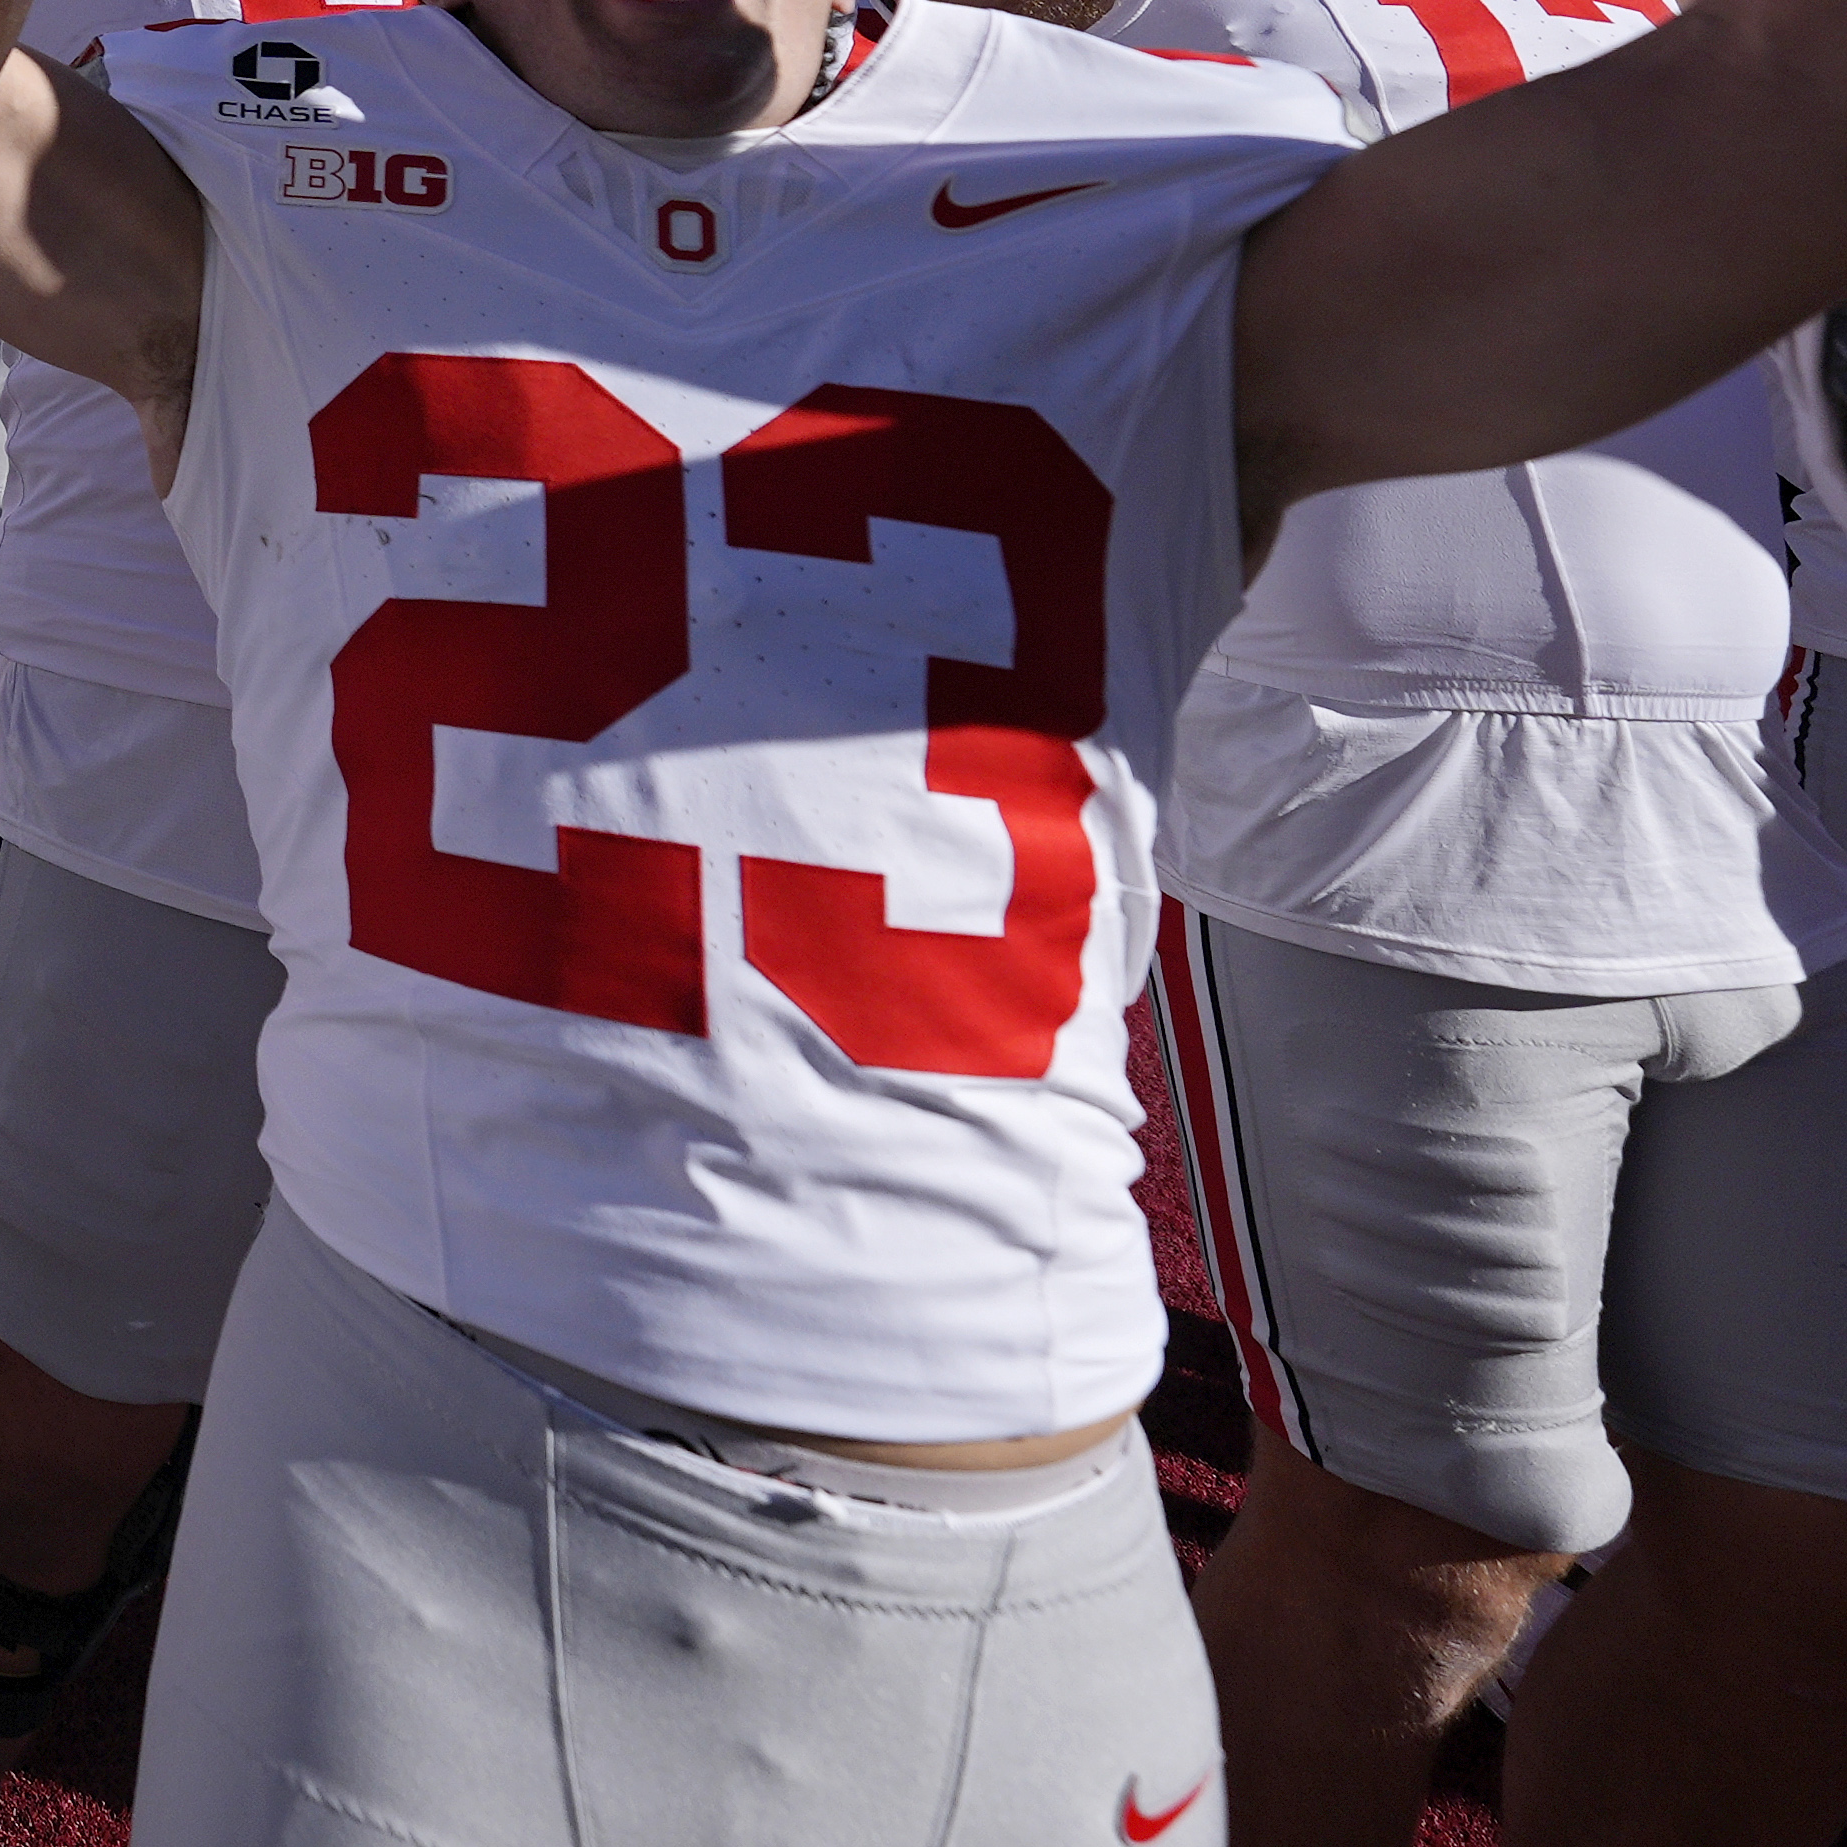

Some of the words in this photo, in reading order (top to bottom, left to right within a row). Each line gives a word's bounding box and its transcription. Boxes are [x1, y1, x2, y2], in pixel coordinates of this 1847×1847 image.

[218, 101, 334, 123] CHASE
[656, 199, 717, 262] O
[308, 351, 1115, 1078] 23
